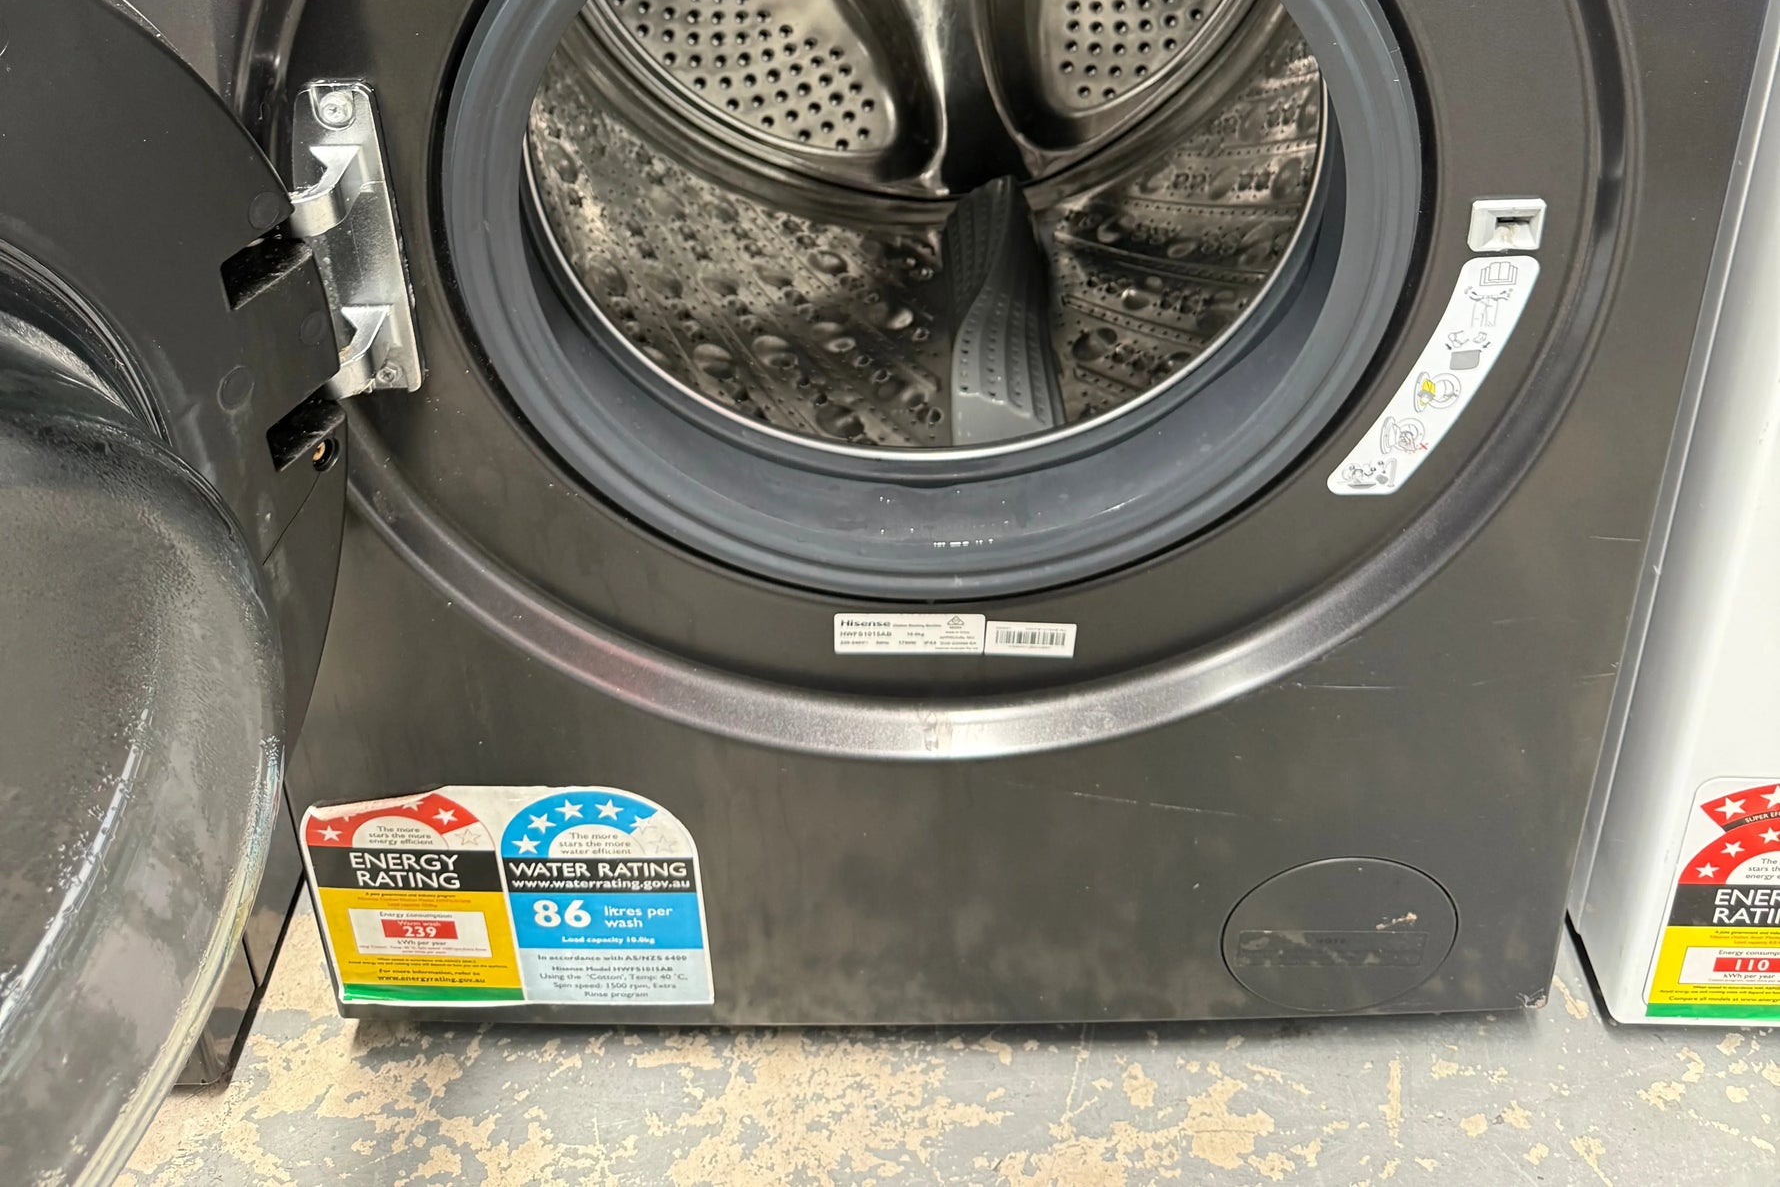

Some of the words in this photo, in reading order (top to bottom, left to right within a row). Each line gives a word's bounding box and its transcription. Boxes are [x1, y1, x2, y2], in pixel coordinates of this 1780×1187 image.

[840, 619, 891, 627] Hisense
[1745, 813, 1769, 823] SUPER
[569, 832, 588, 840] The
[349, 852, 459, 871] ENERGY
[509, 862, 591, 877] WATER
[598, 861, 687, 877] RATING
[356, 870, 461, 889] RATING
[512, 878, 691, 891] www.waterrating.gov.au
[533, 899, 592, 928] 86
[604, 905, 642, 917] litres
[647, 907, 673, 919] per
[604, 918, 643, 928] wash
[403, 926, 437, 938] 239
